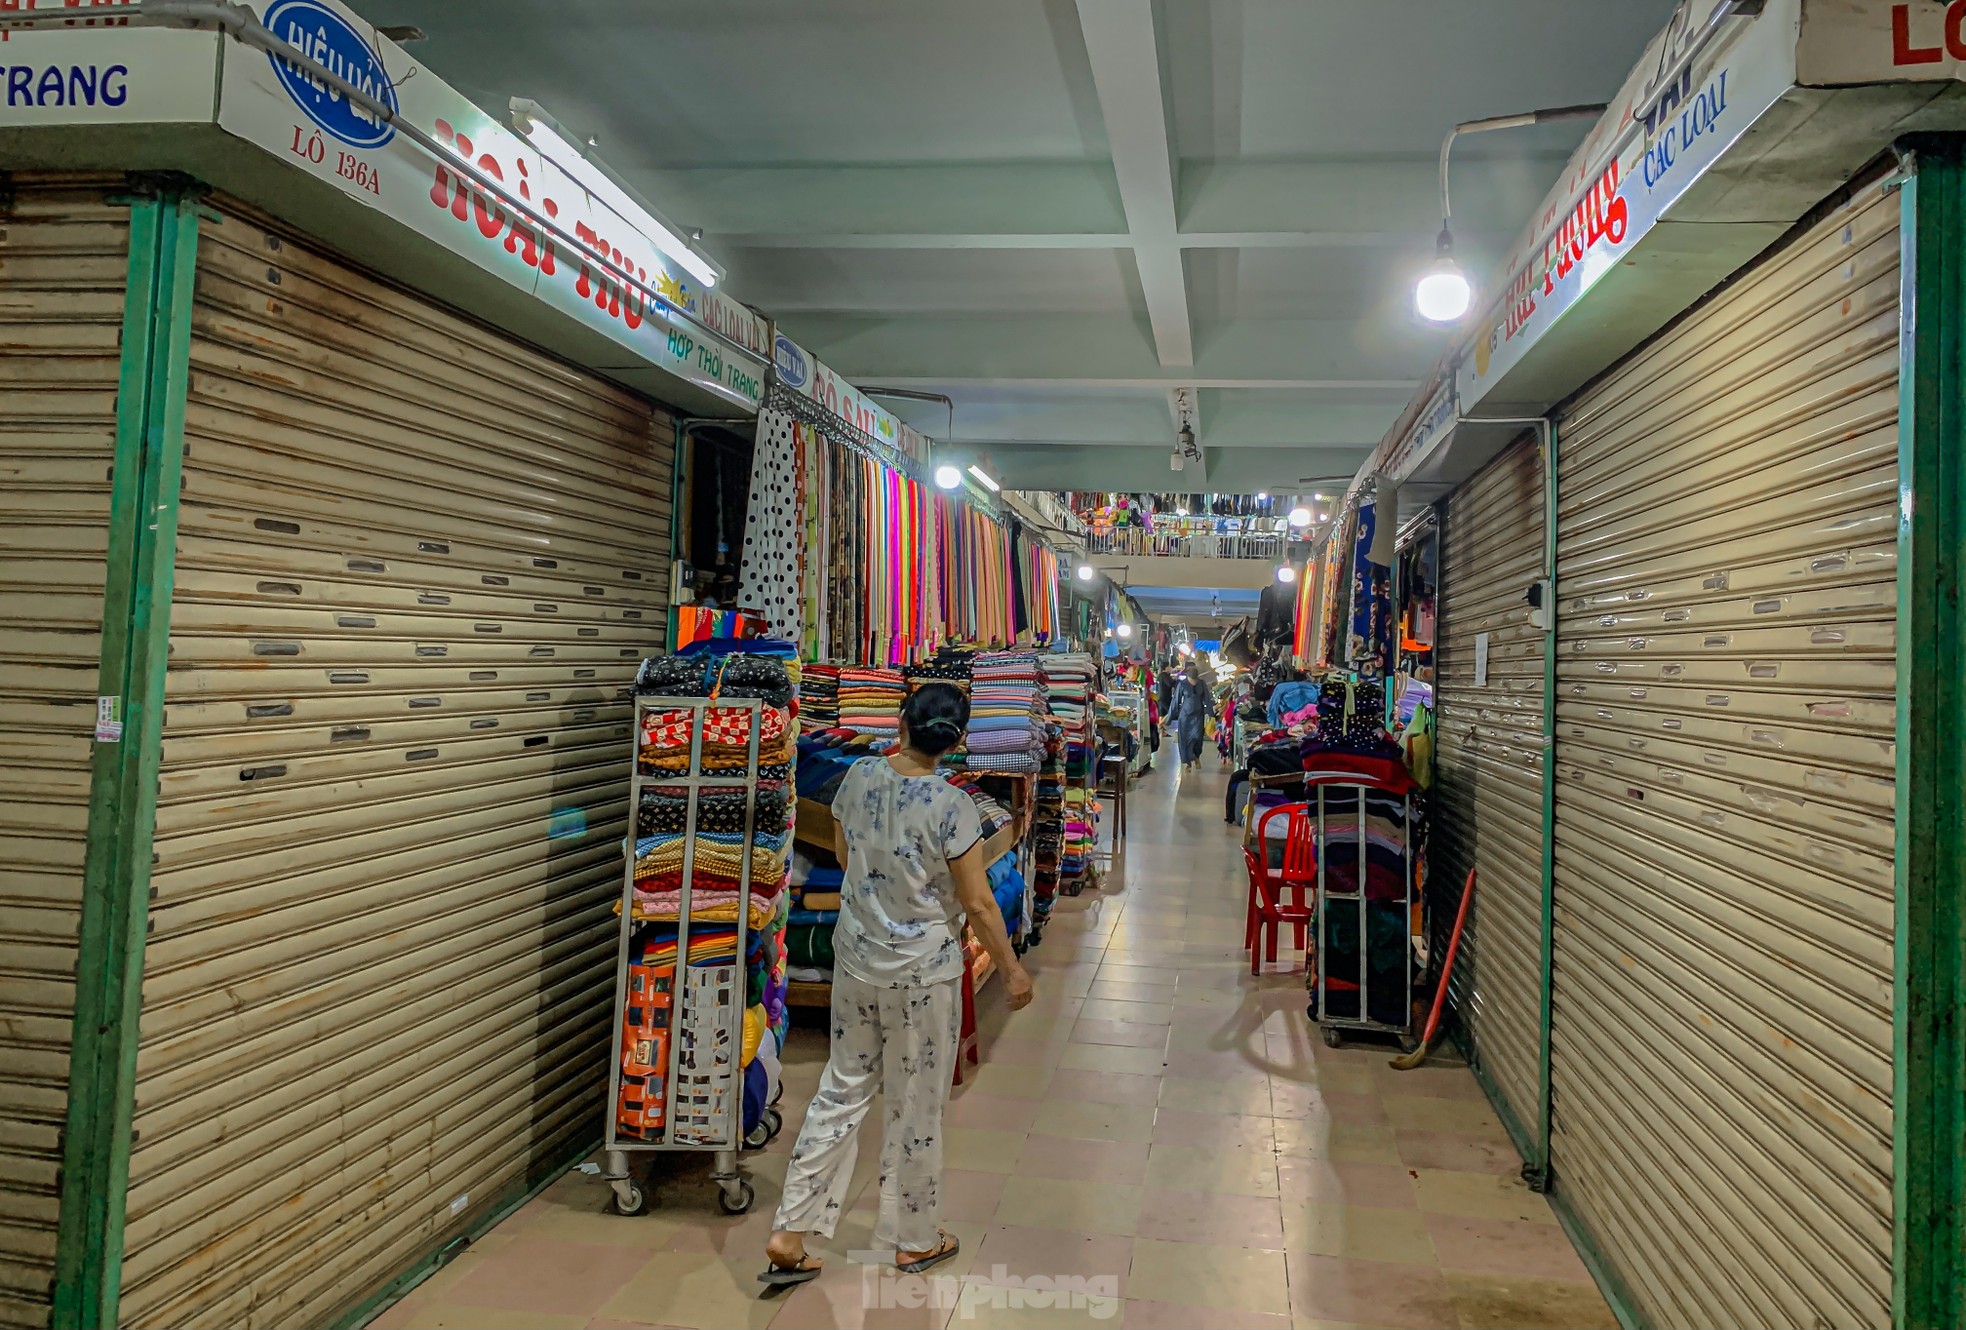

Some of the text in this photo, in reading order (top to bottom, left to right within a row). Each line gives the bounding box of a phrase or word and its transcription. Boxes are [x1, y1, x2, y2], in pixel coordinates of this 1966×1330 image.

[287, 21, 343, 103] HIỆU
[290, 124, 381, 196] LÔ 136A
[1643, 67, 1729, 188] CÁC LOẠI
[667, 327, 760, 401] HỢP THỜI TRANG
